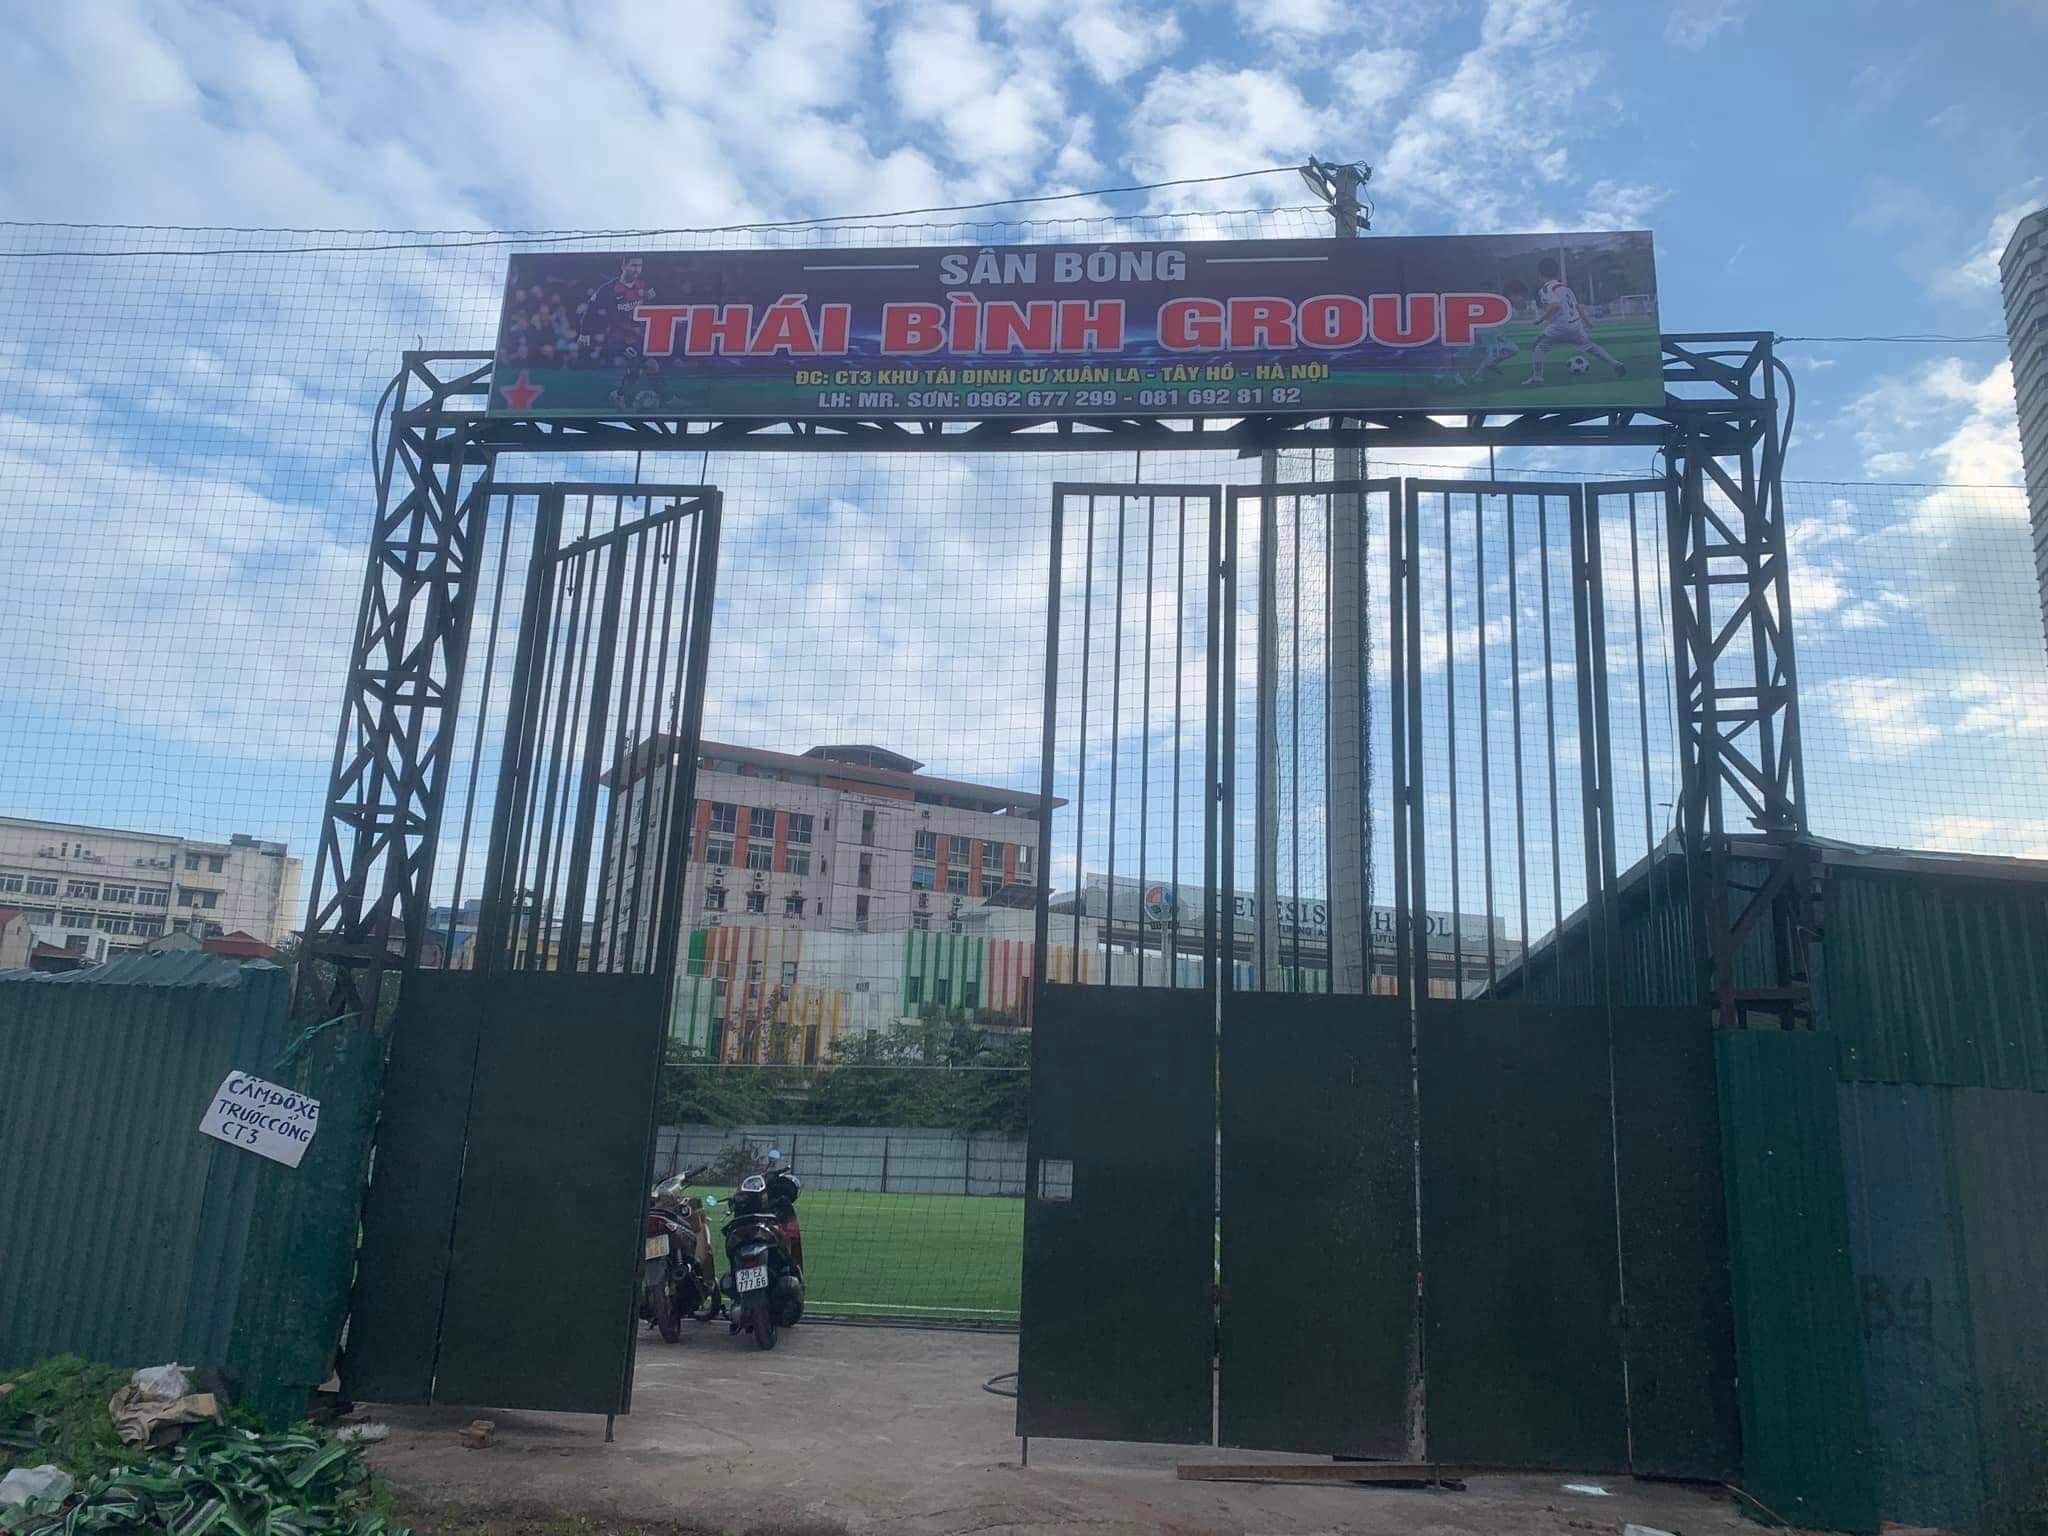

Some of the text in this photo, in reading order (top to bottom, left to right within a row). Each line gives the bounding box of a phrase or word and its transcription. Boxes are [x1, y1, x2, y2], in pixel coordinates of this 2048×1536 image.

[939, 245, 1187, 286] SÂN BÓNG
[633, 292, 1512, 357] THÁI BÌNH GROUP
[795, 370, 828, 385] ĐC:
[835, 370, 872, 385] CT3
[878, 369, 920, 385] KHU
[925, 366, 956, 385] TÁI
[962, 368, 1012, 388] ĐỊNH
[1018, 367, 1049, 384] CƯ
[1052, 365, 1109, 384] XUÂN
[1115, 367, 1141, 383] LA
[1162, 363, 1200, 382] TÂY
[1256, 361, 1285, 380] HÀ
[1291, 361, 1329, 382] NỘI
[818, 391, 850, 408] LH:
[857, 391, 900, 408] MR.
[907, 391, 959, 408] SƠN:
[967, 390, 1021, 408] 0962
[1027, 390, 1069, 407] 677
[1075, 390, 1117, 407] 299
[1140, 389, 1179, 406] 081
[1188, 388, 1230, 405] 692
[1237, 388, 1262, 404] 81
[1272, 387, 1301, 404] 82
